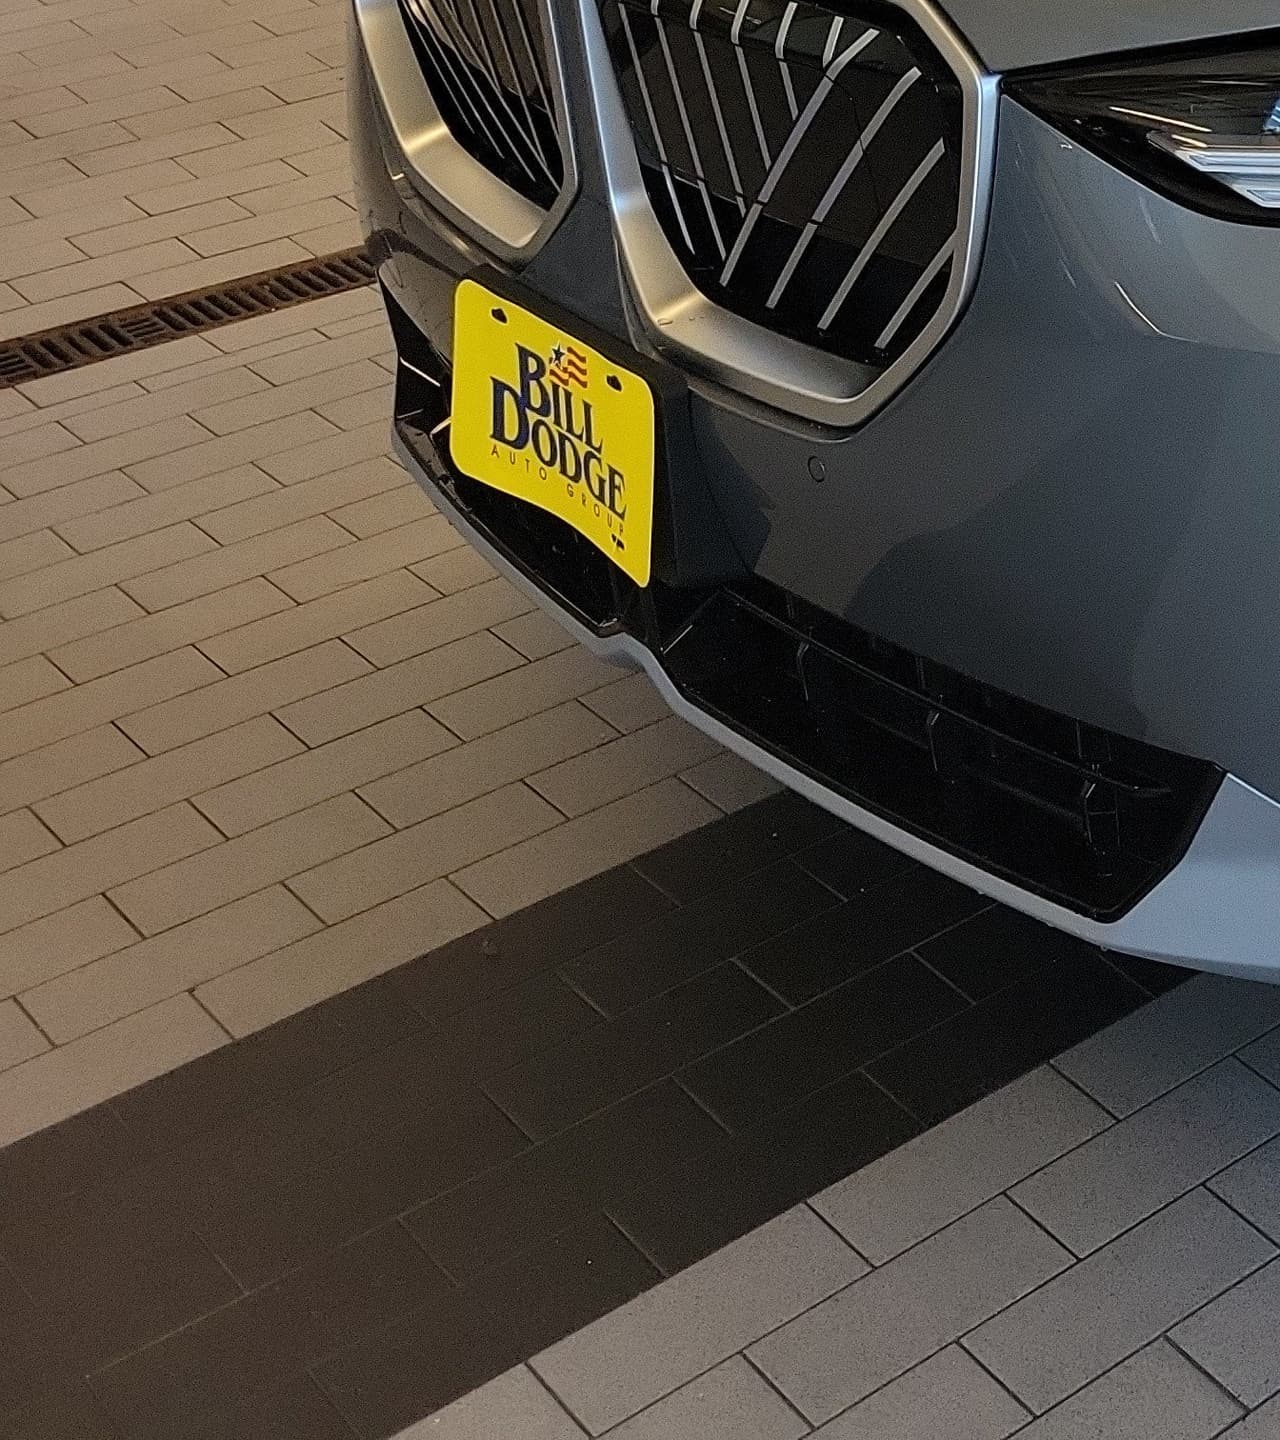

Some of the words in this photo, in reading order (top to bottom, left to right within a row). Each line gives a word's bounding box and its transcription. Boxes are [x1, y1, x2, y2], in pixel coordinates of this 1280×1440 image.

[489, 376, 627, 522] DODGE
[515, 343, 604, 455] BILL
[490, 445, 548, 482] AUTO
[567, 483, 625, 537] GROUP
